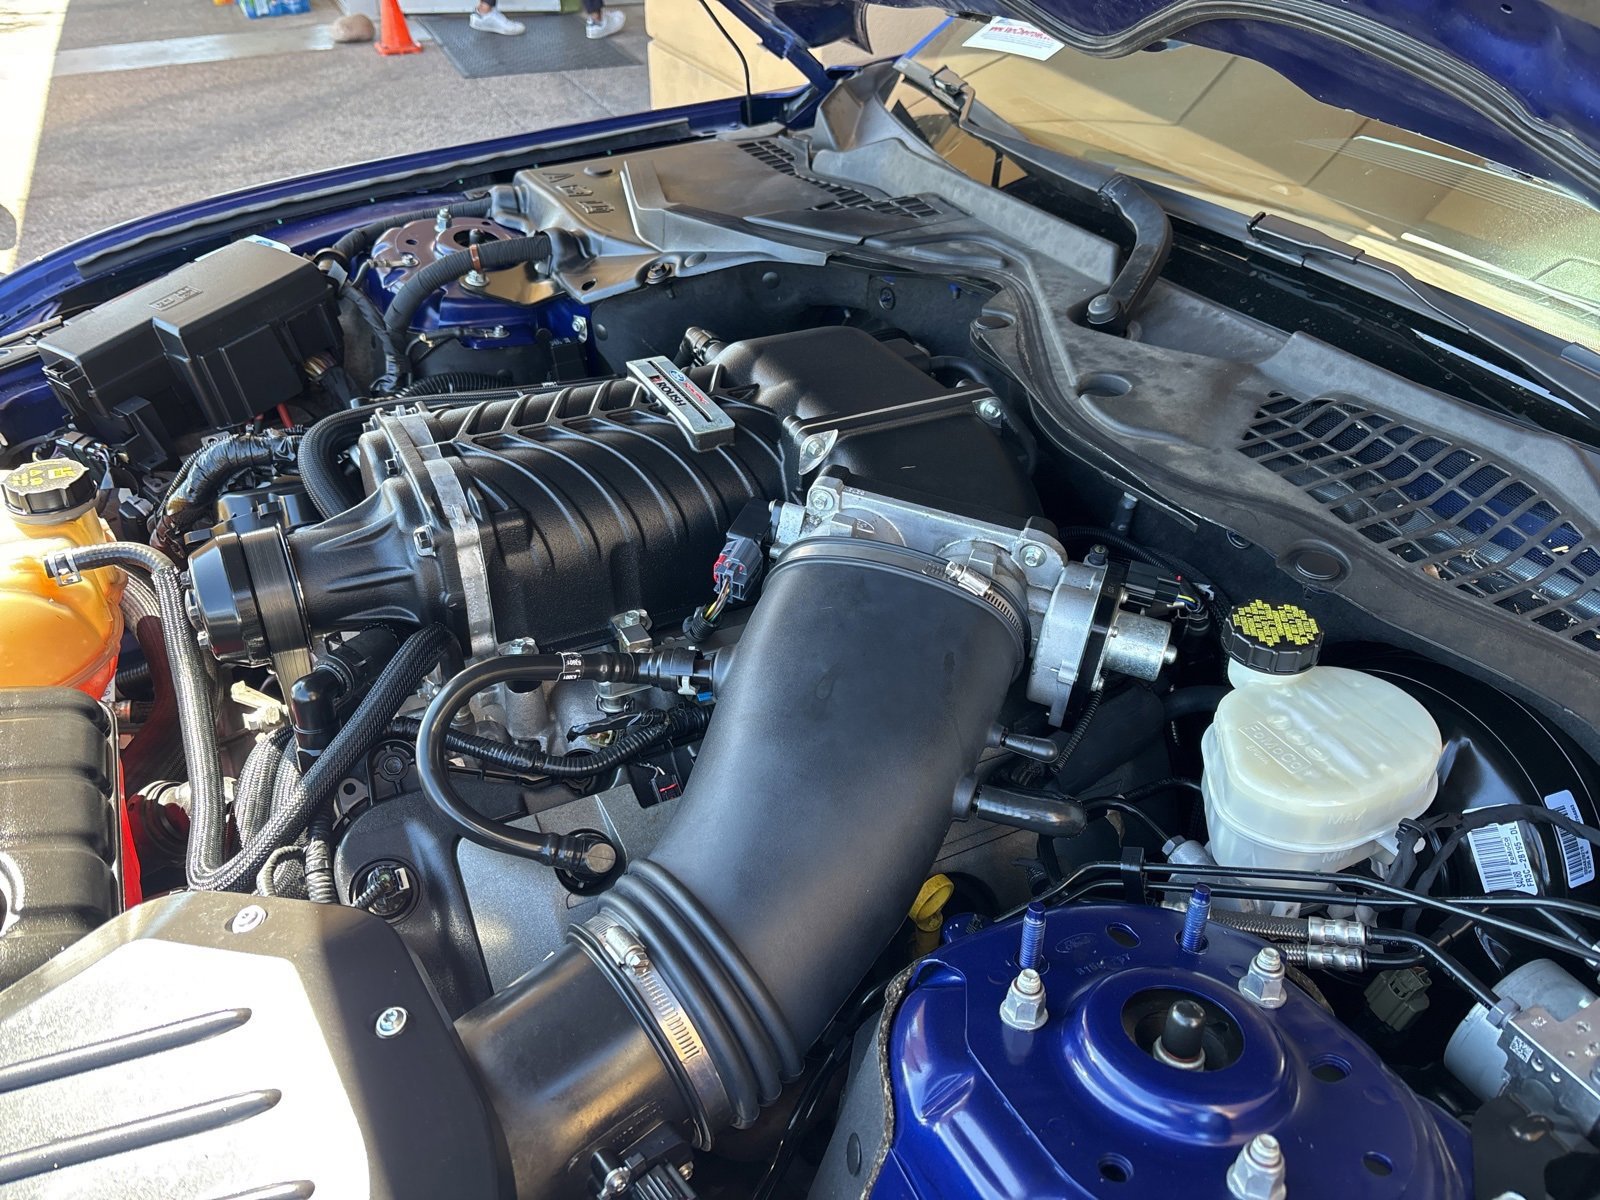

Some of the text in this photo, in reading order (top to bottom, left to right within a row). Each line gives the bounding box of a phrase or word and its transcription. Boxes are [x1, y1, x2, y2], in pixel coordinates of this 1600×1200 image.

[657, 382, 687, 406] ROUSH
[1245, 725, 1303, 770] FoMoCo
[1503, 837, 1515, 865] FoMoCo
